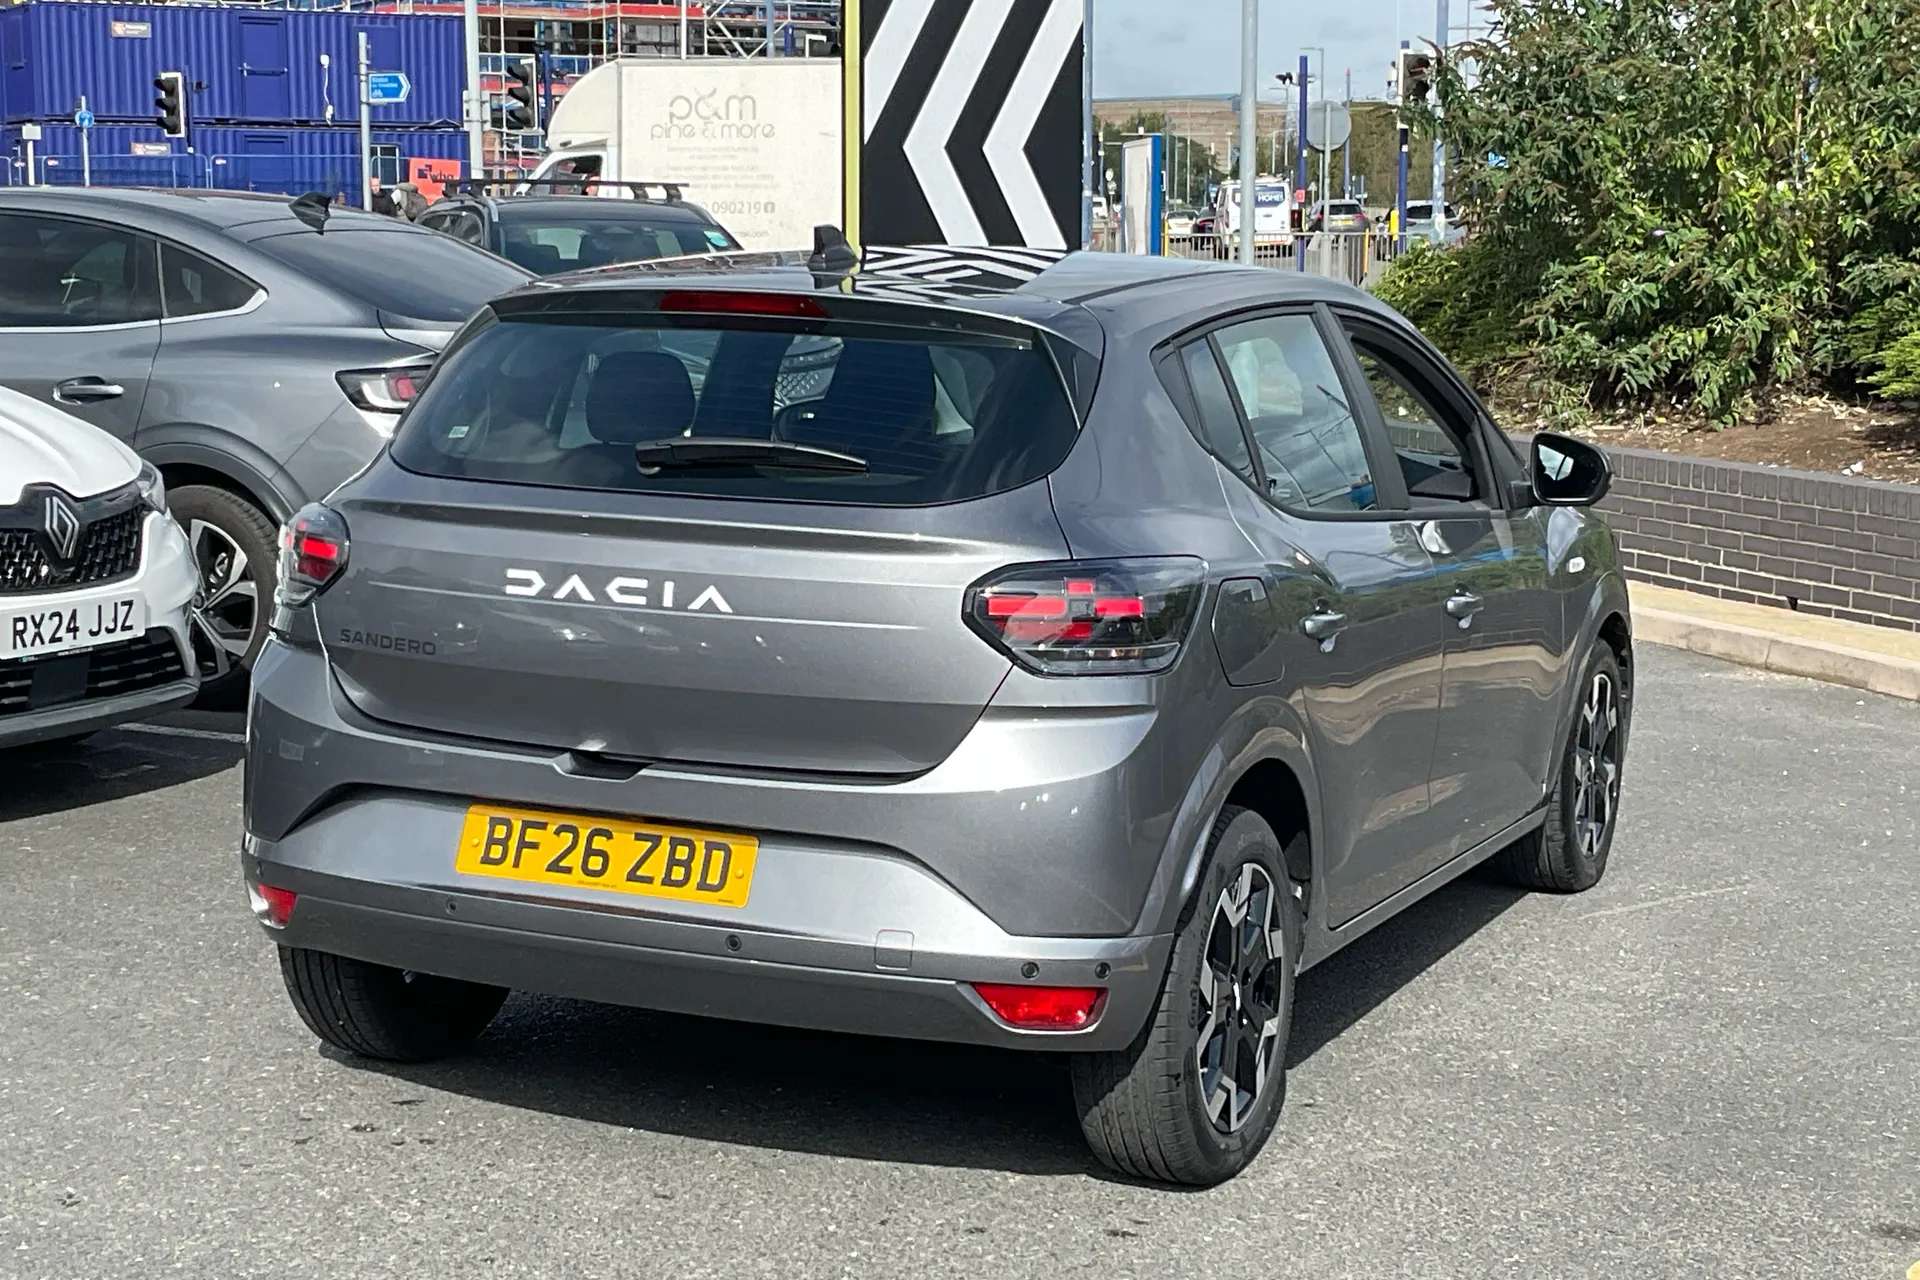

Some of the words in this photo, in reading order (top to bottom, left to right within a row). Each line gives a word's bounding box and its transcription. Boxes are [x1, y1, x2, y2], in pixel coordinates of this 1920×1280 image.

[650, 122, 696, 140] pine
[702, 121, 717, 139] &
[720, 123, 776, 139] more
[711, 200, 761, 215] 090219
[505, 568, 733, 614] DACIA
[12, 608, 80, 650] RX24
[88, 599, 134, 637] JJZ
[340, 628, 437, 656] SANDERO
[480, 815, 616, 878] BF26
[625, 831, 733, 893] ZBD
